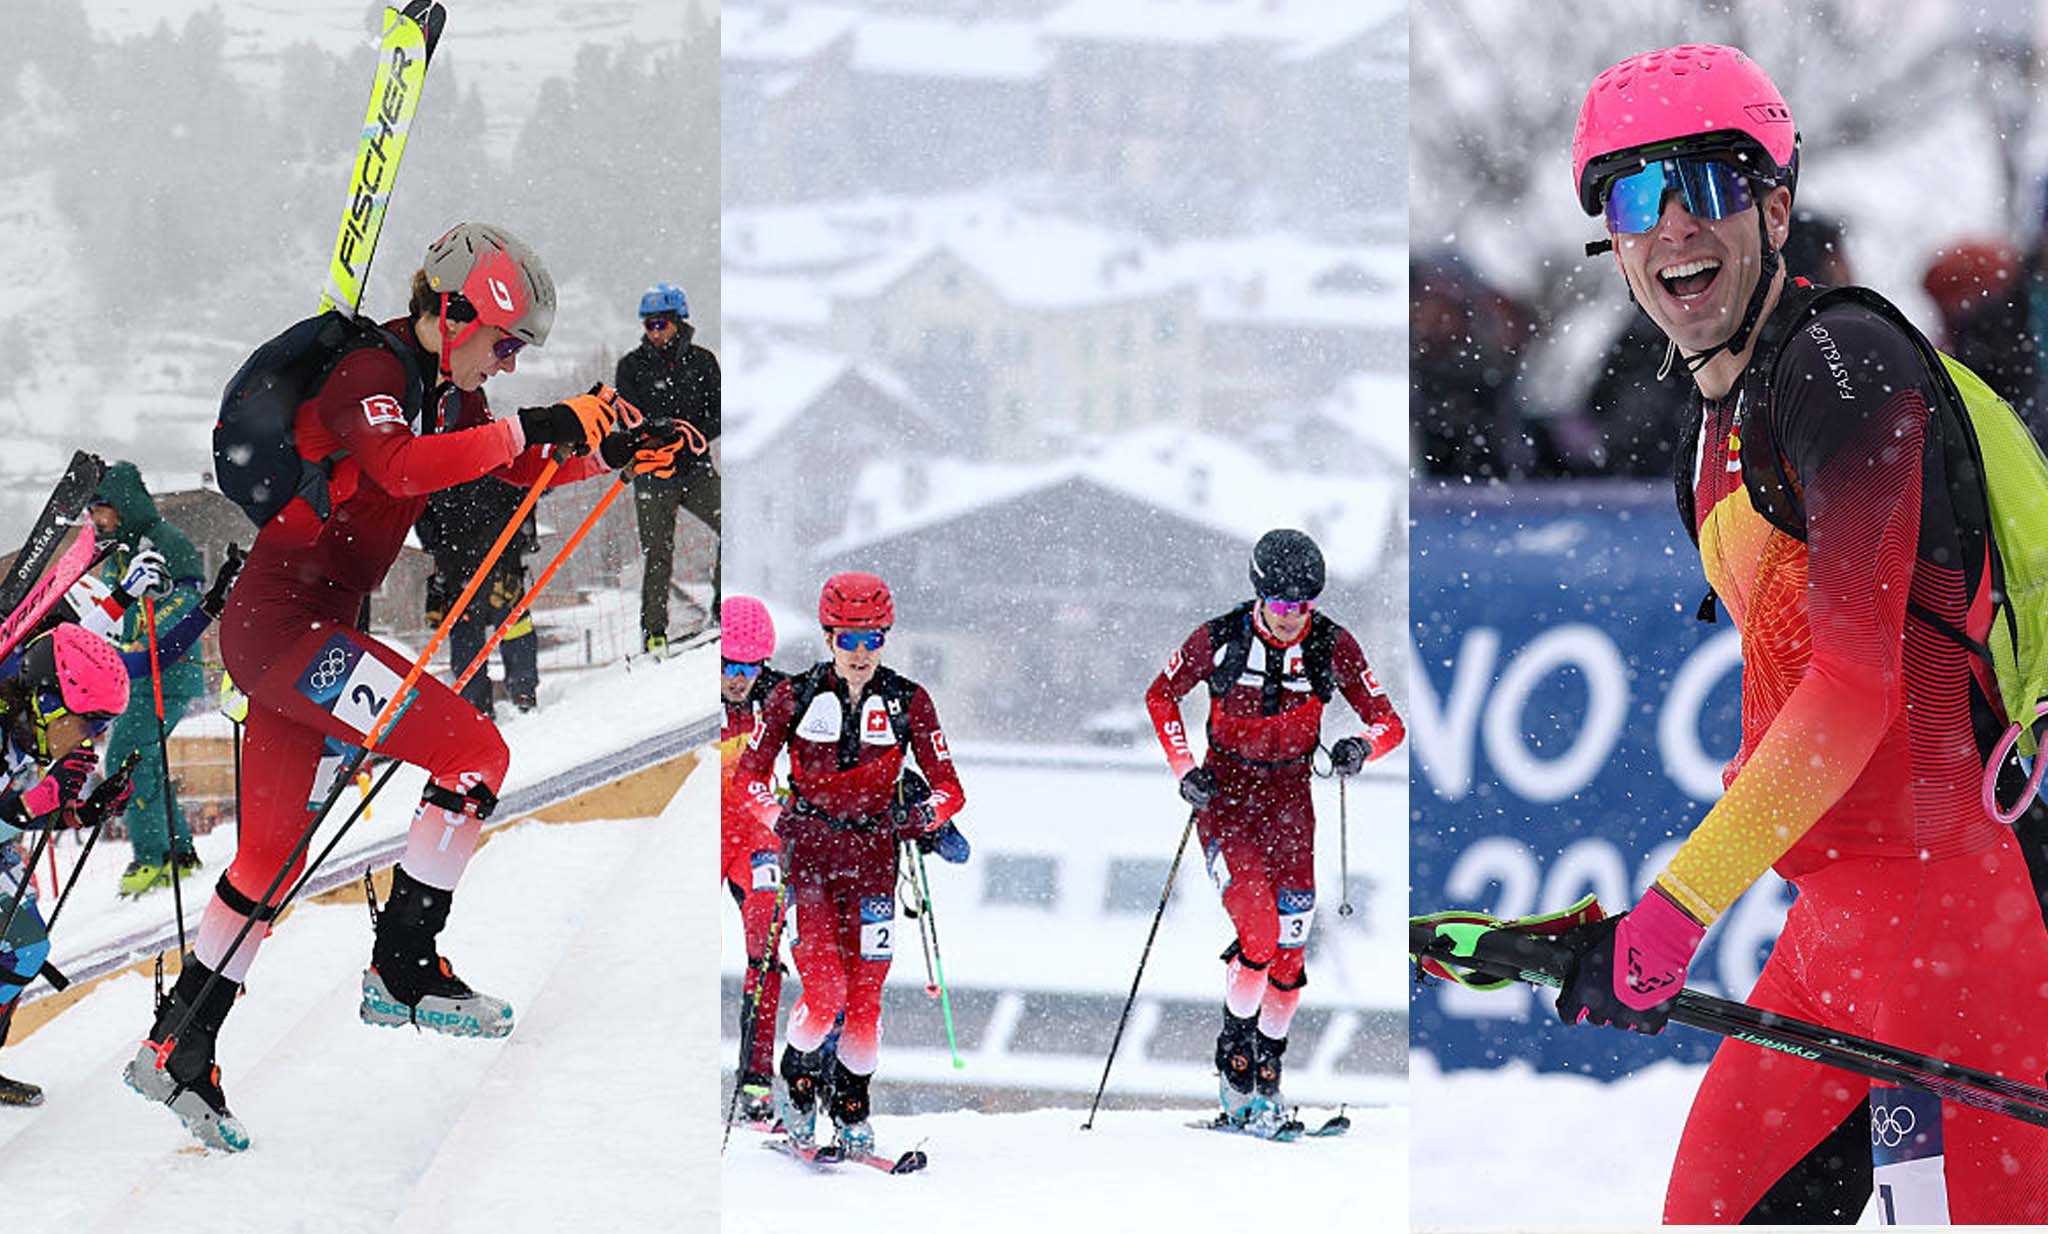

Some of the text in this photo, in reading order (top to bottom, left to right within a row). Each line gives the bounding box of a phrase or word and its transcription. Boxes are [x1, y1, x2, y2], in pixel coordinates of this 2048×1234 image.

[339, 46, 412, 278] FISCHER
[18, 526, 56, 581] DYNASTAR
[351, 683, 388, 718] 2
[876, 927, 890, 949] 2
[1290, 919, 1304, 938] 3
[1880, 1184, 1897, 1225] 1
